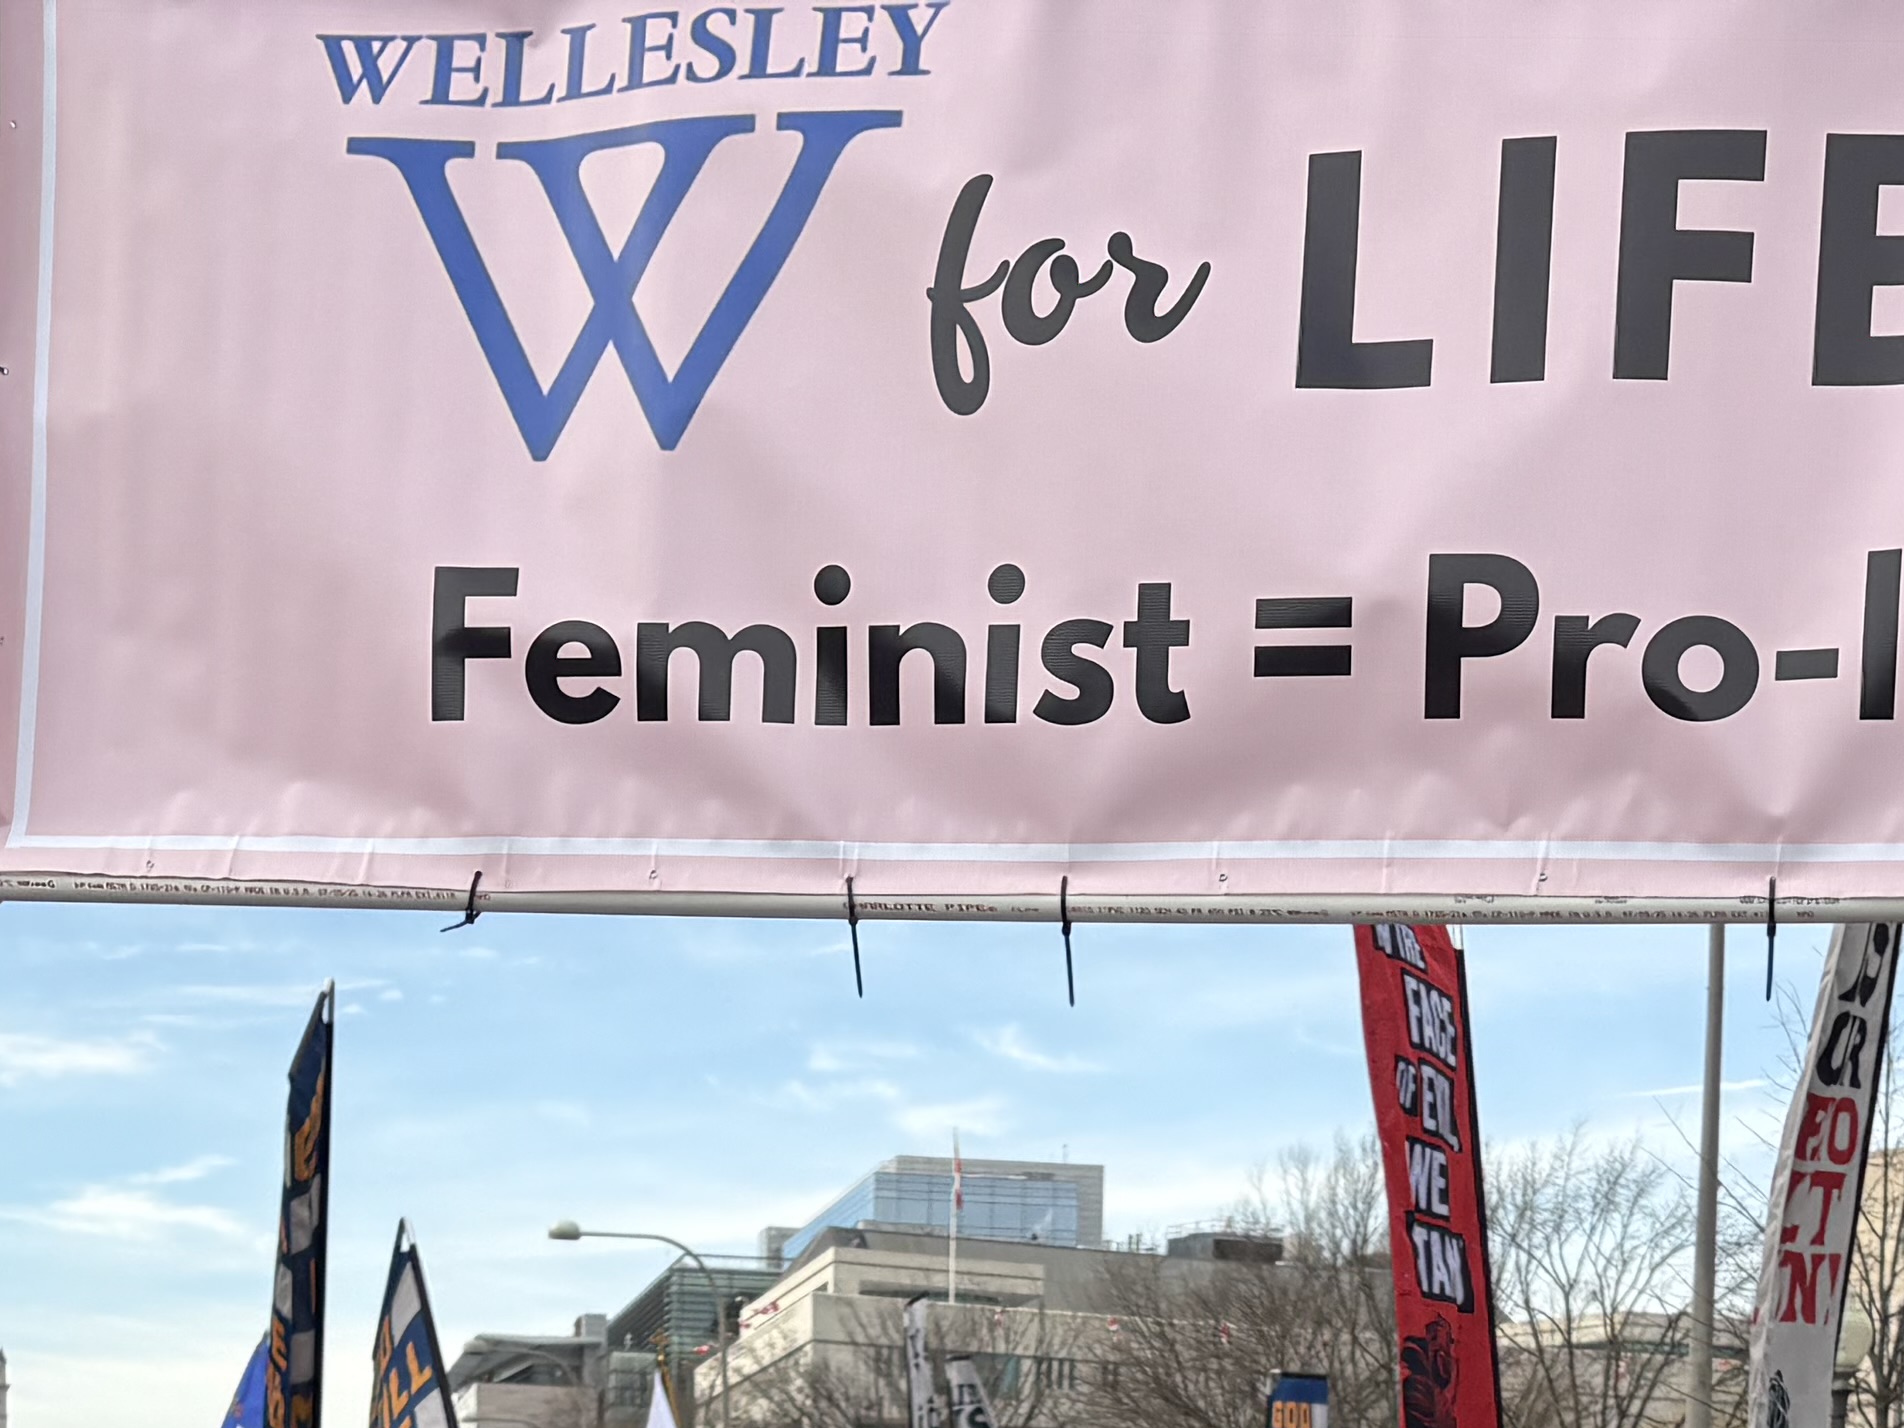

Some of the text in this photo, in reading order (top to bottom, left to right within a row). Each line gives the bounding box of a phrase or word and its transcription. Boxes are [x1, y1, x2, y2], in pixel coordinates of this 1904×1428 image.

[316, 1, 950, 108] WELLESLEY
[346, 109, 903, 462] W
[926, 172, 1209, 416] for
[428, 562, 1191, 728] Feminist
[842, 902, 937, 913] CARLOTTE
[1404, 973, 1457, 1069] FACE
[1397, 1058, 1418, 1110] OF
[1407, 1140, 1450, 1218] WE
[1412, 1222, 1466, 1306] TAN
